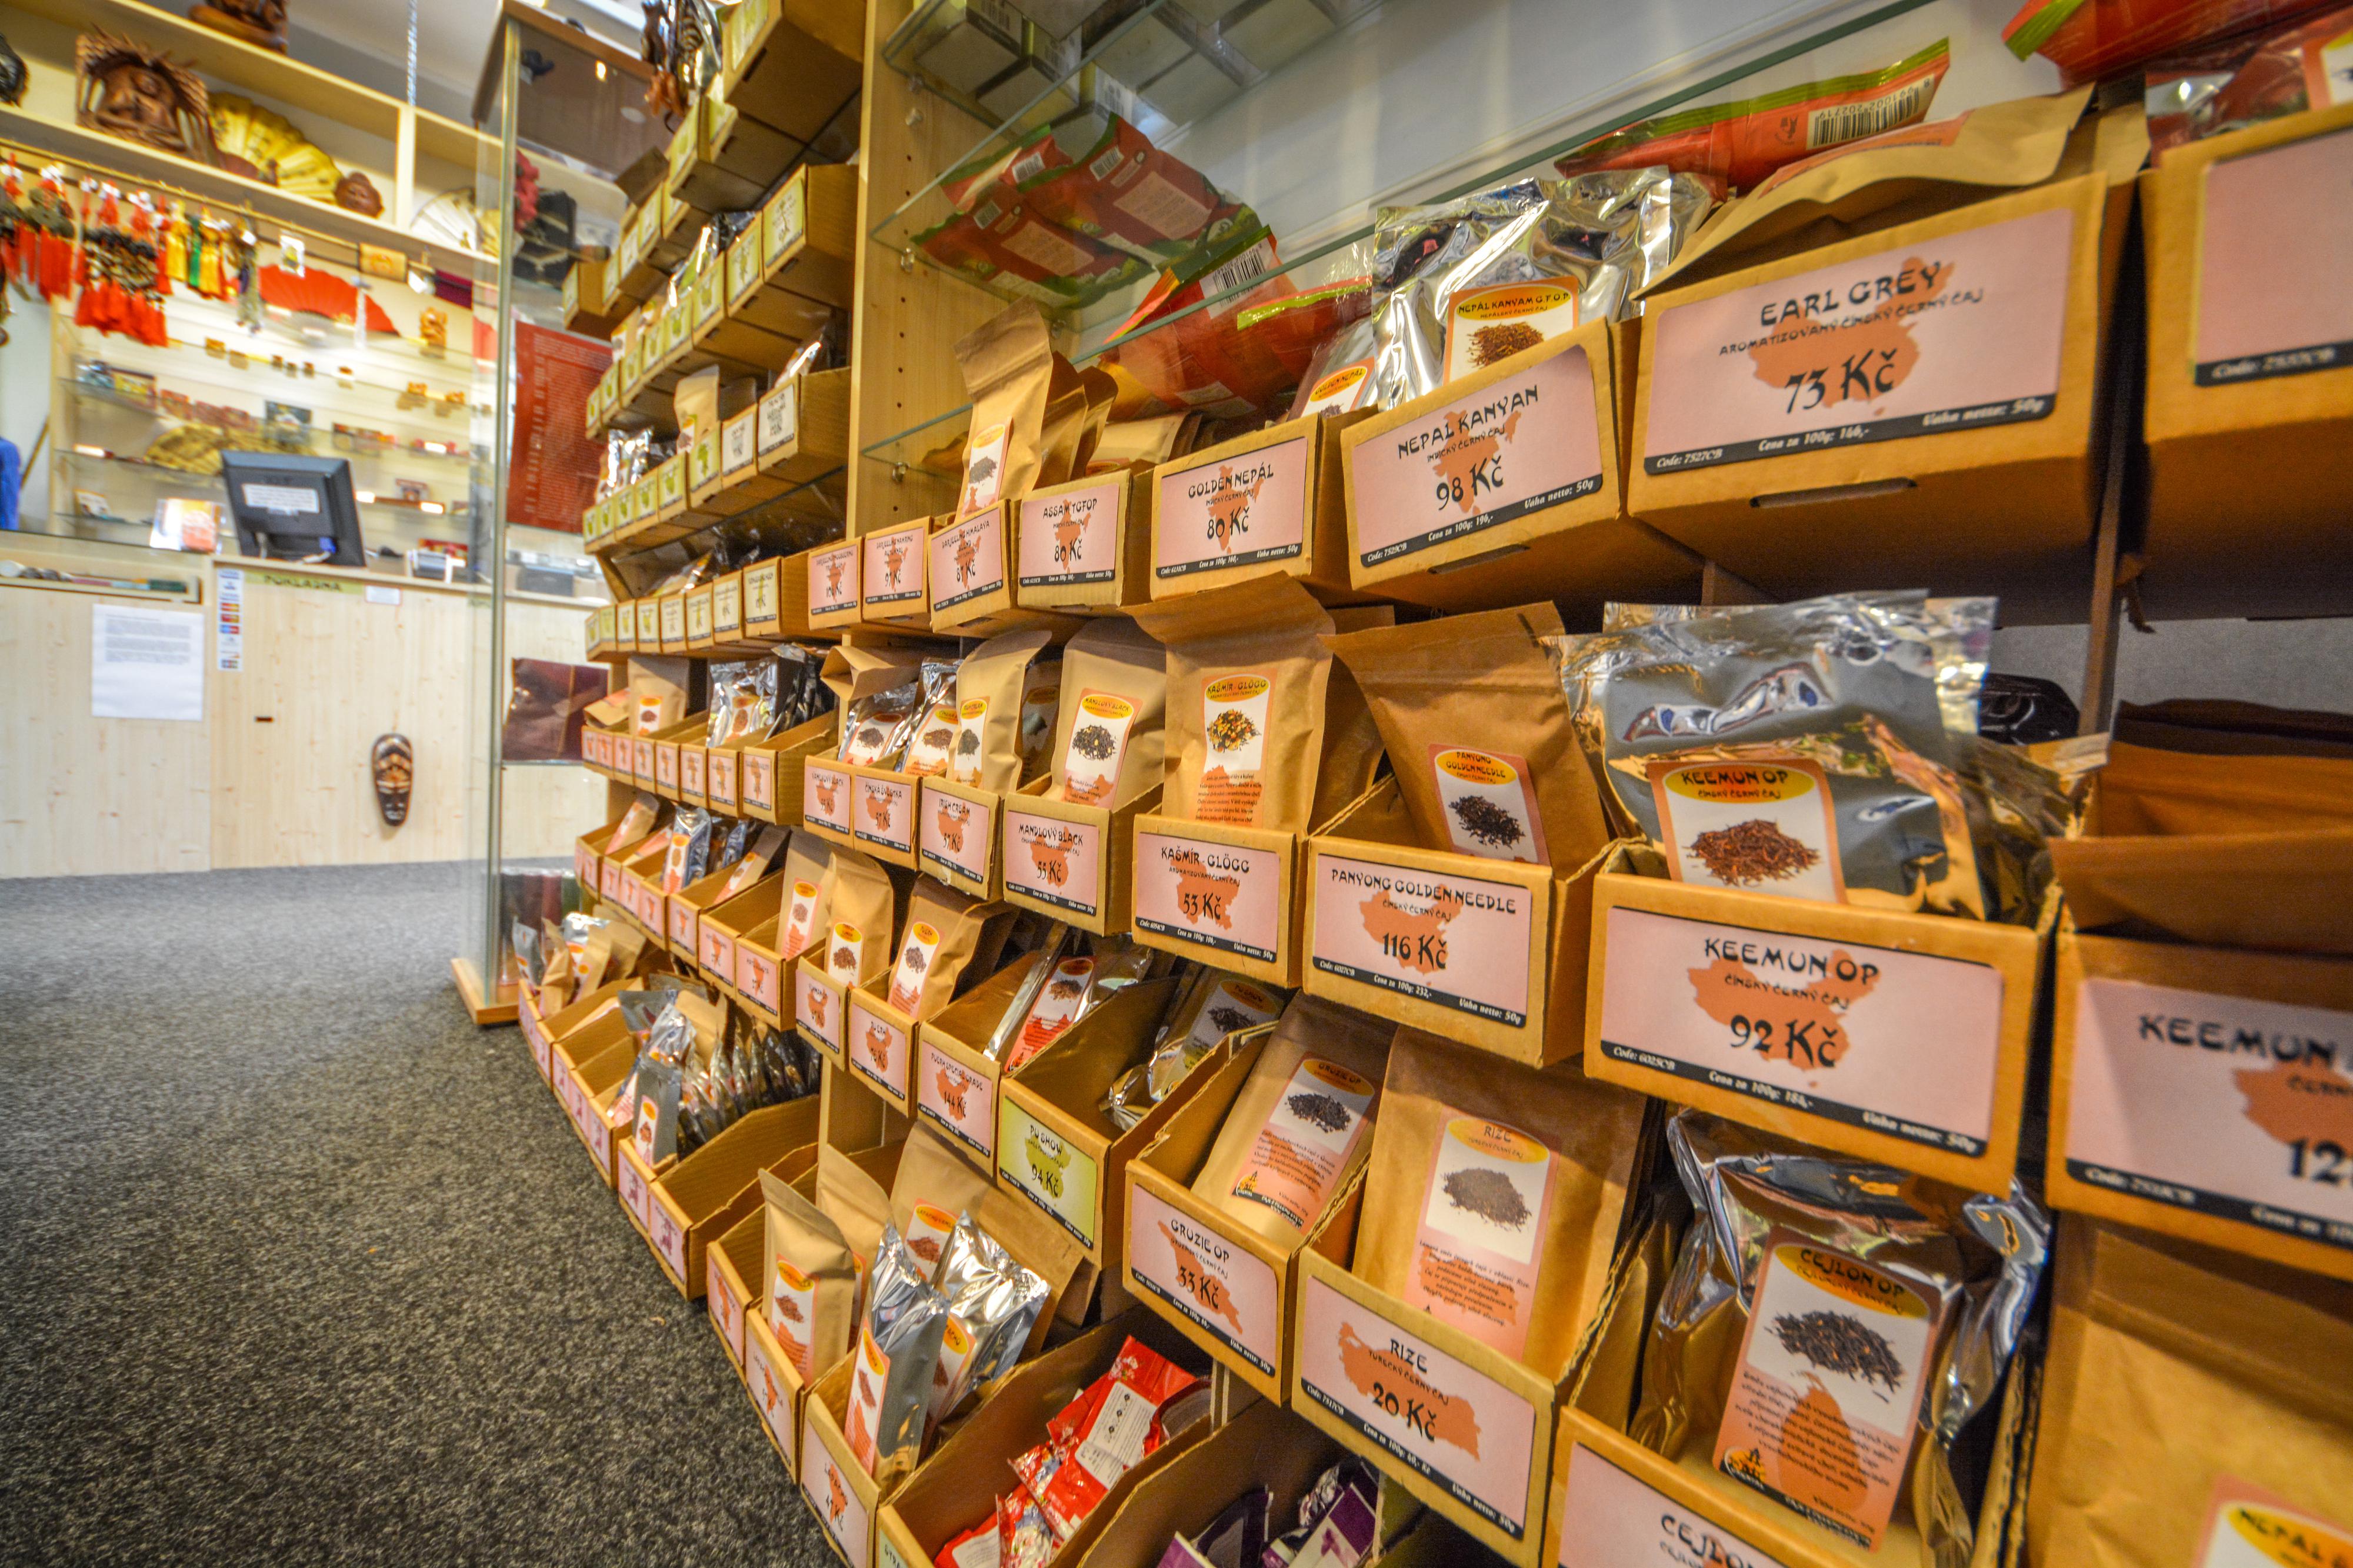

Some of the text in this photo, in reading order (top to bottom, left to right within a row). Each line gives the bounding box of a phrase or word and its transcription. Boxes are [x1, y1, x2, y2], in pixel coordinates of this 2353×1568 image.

[1459, 297, 1533, 313] NEPÁL KANYAM
[1761, 261, 1941, 326] EARL GREY
[1719, 319, 1838, 355] AROMATIZOVANÝ
[1897, 295, 1948, 318] ČERNÝ
[1951, 288, 1984, 305] ČAJ
[1785, 348, 1898, 413] 73 Kč
[1458, 385, 1539, 433] KANYAN
[2011, 398, 2045, 413] 50g
[1427, 423, 1506, 463] INDICKÝ ČERNÝ ČAJ
[1758, 430, 1834, 452] Cena za 100g:
[1657, 456, 1682, 468] Code:
[1188, 462, 1274, 499] GOLDEN NEPÁL
[1436, 455, 1504, 511] 98 Kč
[1525, 478, 1594, 509] Váha netto: 50g
[1043, 503, 1071, 519] ASSAM
[1207, 505, 1249, 539] 80 Kč
[966, 520, 990, 536] HIMALAYA
[1428, 532, 1443, 541] Cena
[1445, 528, 1452, 536] za
[1455, 521, 1473, 533] 100g:
[1055, 537, 1082, 562] 80 Kč
[1215, 556, 1227, 566] 100g:
[1271, 544, 1298, 556] netto: 50g
[1368, 552, 1383, 562] Code:
[894, 569, 901, 585] Kč
[966, 558, 976, 579] Kč
[1207, 682, 1234, 695] KAŠMÍR
[1457, 752, 1491, 763] PANYONG
[1681, 770, 1788, 786] KEEMUN OP
[1762, 789, 1781, 799] ČAJ
[939, 798, 970, 815] IRISH CREAM
[883, 810, 891, 828] Kč
[944, 832, 961, 852] 57 Kč
[1019, 823, 1057, 841] MANDLOVÝ
[1059, 831, 1083, 847] BLACK
[1037, 859, 1062, 883] 55 Kč
[1161, 845, 1250, 873] KAŠMÍR GLÖGG
[1229, 878, 1240, 888] ČAJ
[1332, 869, 1517, 914] PANYONG GOLDEN NEEDLE
[1183, 892, 1221, 920] 53 Kč
[1382, 899, 1452, 923] ČÍNSKÝ ČERNÝ ČAJ
[1140, 919, 1149, 928] Code:
[1178, 928, 1204, 942] Cena 100g:
[1234, 942, 1273, 960] Váha netto: 50g
[1382, 932, 1447, 970] 116 Kč
[1704, 937, 1879, 986] KEEMUN OP
[1320, 960, 1334, 970] Code:
[1374, 975, 1432, 999] Cena za 100g: 232,-
[1725, 972, 1850, 1012] ČÍNSKÝ ČERNÝ ČAJ
[1459, 997, 1521, 1025] Váha netto: 50g
[1614, 1046, 1638, 1061] Code:
[1729, 1014, 1838, 1069] 92 Kč
[2138, 1013, 2335, 1070] KEEMUN
[965, 1073, 983, 1091] GRADE
[1709, 1070, 1781, 1100] Cena za 100g:
[944, 1091, 967, 1118] 144 Kč
[1040, 1131, 1063, 1155] SHOW
[1484, 1125, 1512, 1143] RIZE
[1947, 1132, 1978, 1154] 50g
[1032, 1163, 1059, 1197] 94 Kč
[1171, 1219, 1229, 1263] GRUZIE OP
[1217, 1267, 1229, 1280] ČAJ
[1801, 1247, 1874, 1289] CEJLON
[1179, 1266, 1219, 1310] 33 Kč
[1173, 1298, 1201, 1322] Cena 100g:
[1244, 1349, 1259, 1363] netto:
[1259, 1358, 1271, 1373] 50g
[1390, 1337, 1428, 1374] RIZE
[1369, 1349, 1449, 1406] TURECKÝ ČERNÝ ČAJ
[1307, 1384, 1322, 1400] Code:
[1372, 1382, 1438, 1444] 20 Kč
[1364, 1422, 1405, 1457] Cena za 100g:
[1473, 1495, 1497, 1519] netto:
[1498, 1512, 1517, 1535] 50g
